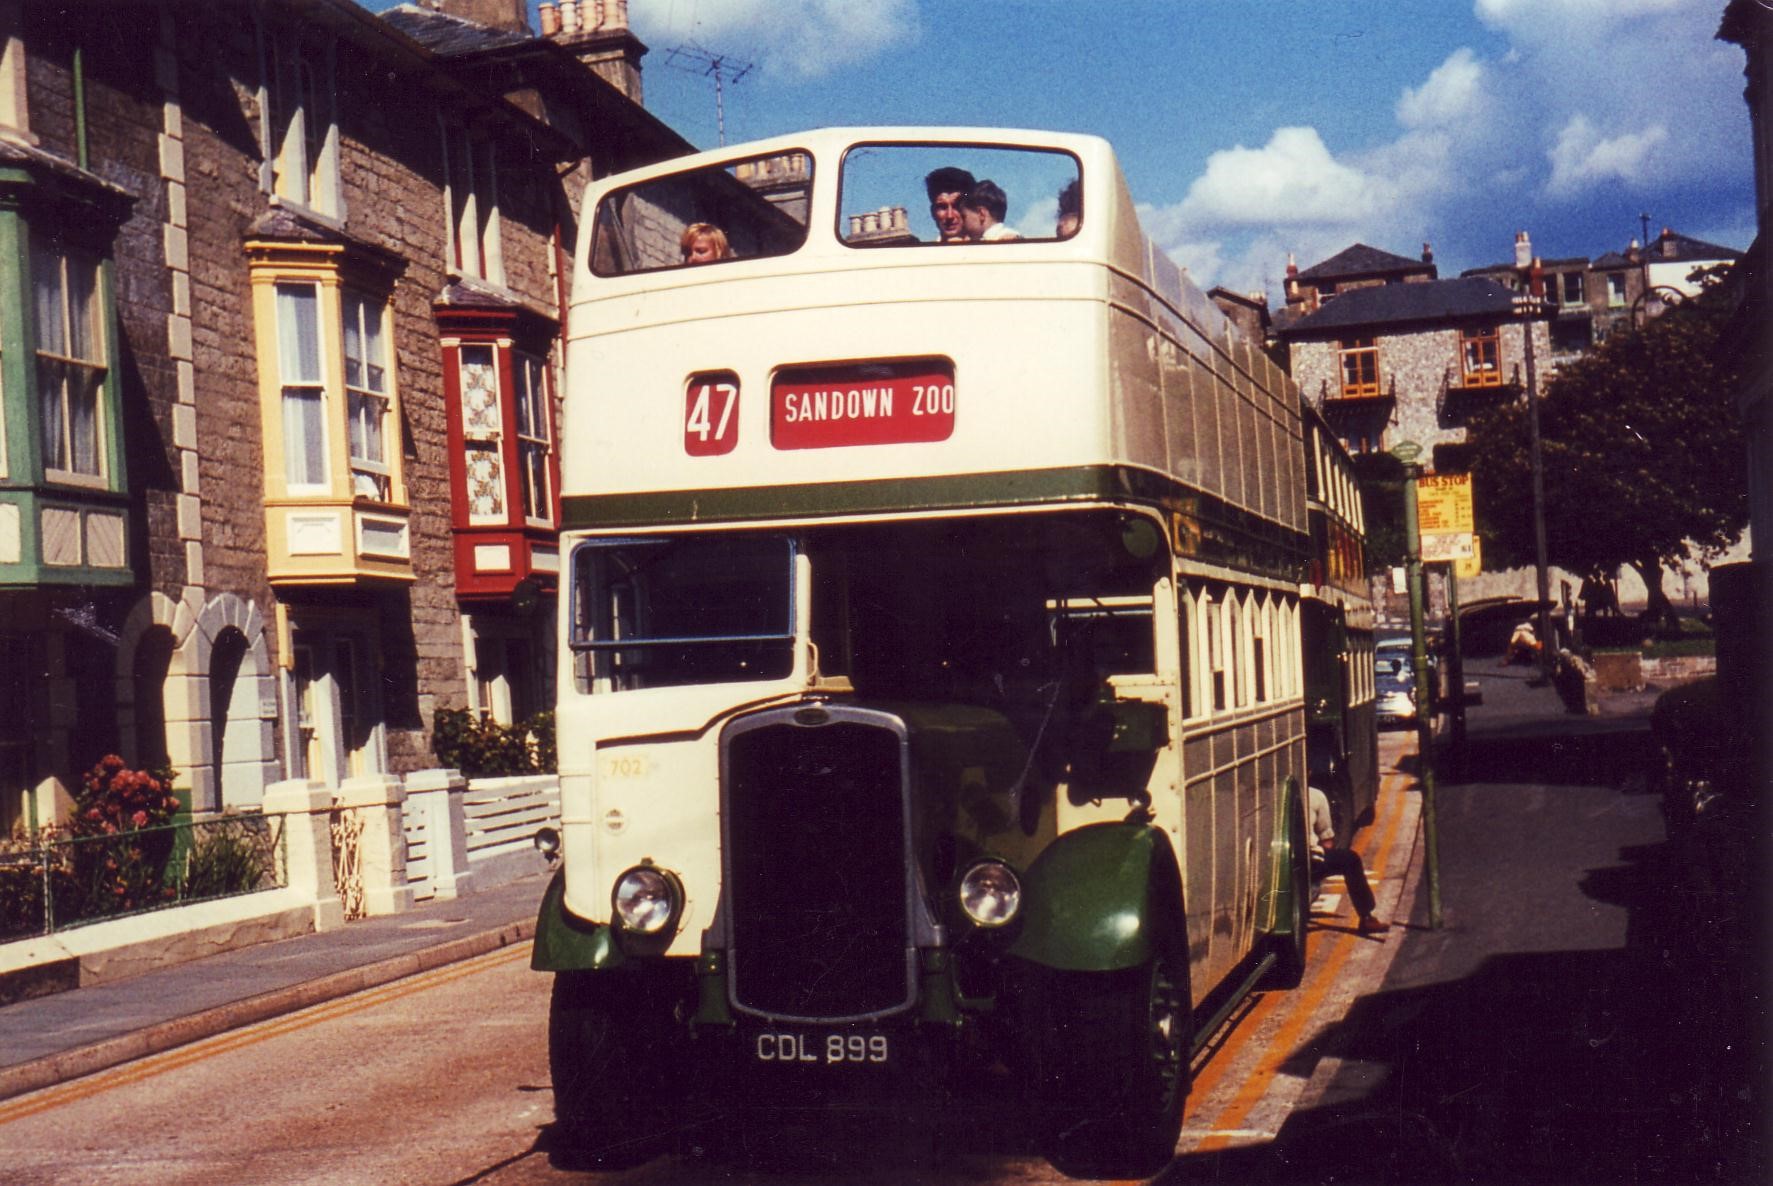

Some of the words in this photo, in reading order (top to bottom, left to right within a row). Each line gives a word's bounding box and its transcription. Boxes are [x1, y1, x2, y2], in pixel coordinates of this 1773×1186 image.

[687, 384, 737, 441] 47
[785, 388, 893, 422] SANDOWN
[912, 385, 954, 416] ZOO
[1418, 477, 1439, 488] BUS
[1441, 474, 1468, 486] STOP
[610, 759, 641, 777] 702
[757, 1034, 818, 1061] CDL
[826, 1034, 888, 1063] 899
